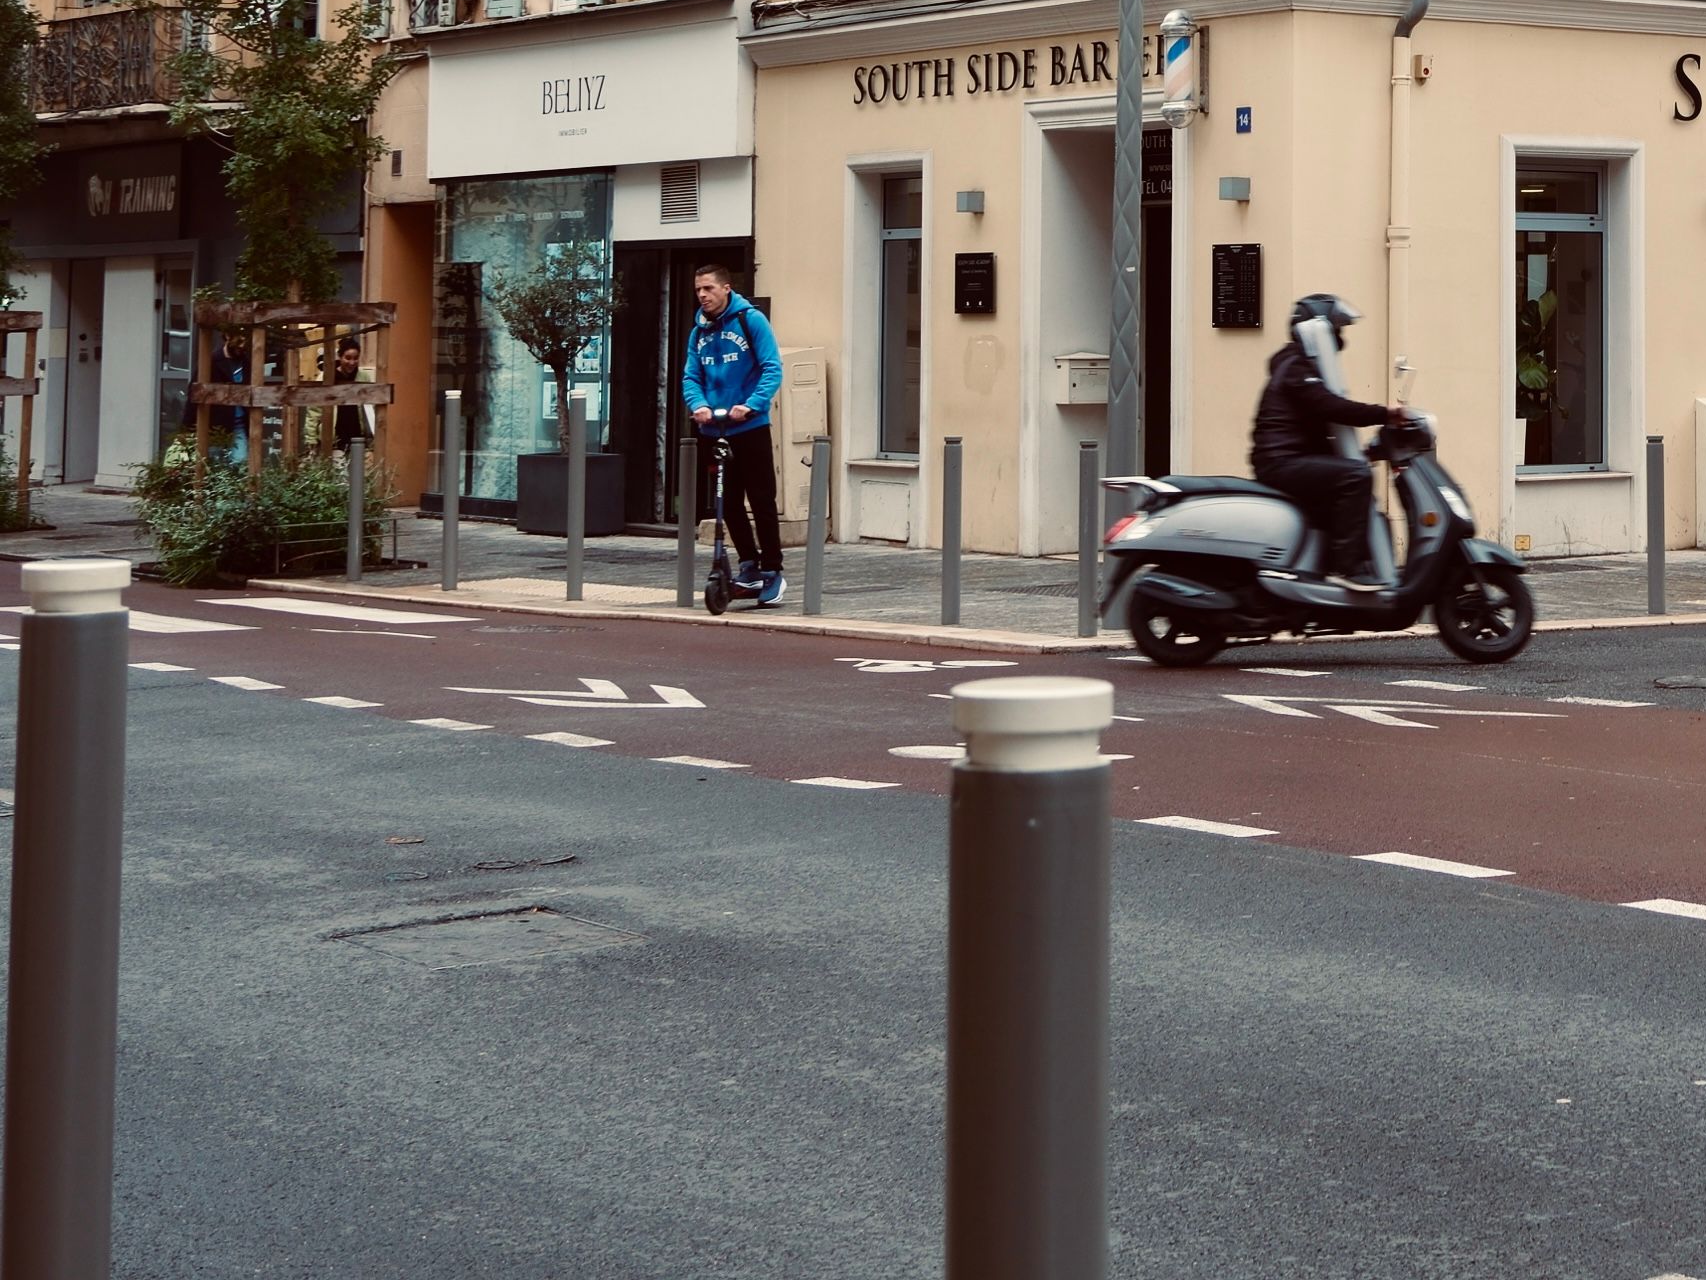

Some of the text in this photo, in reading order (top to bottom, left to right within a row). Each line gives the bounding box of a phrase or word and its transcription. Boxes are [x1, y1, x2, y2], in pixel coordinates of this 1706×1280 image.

[542, 74, 606, 115] BELIYZ
[853, 56, 955, 106] SOUTH
[966, 49, 1037, 96] SIDE
[1239, 113, 1249, 127] 14
